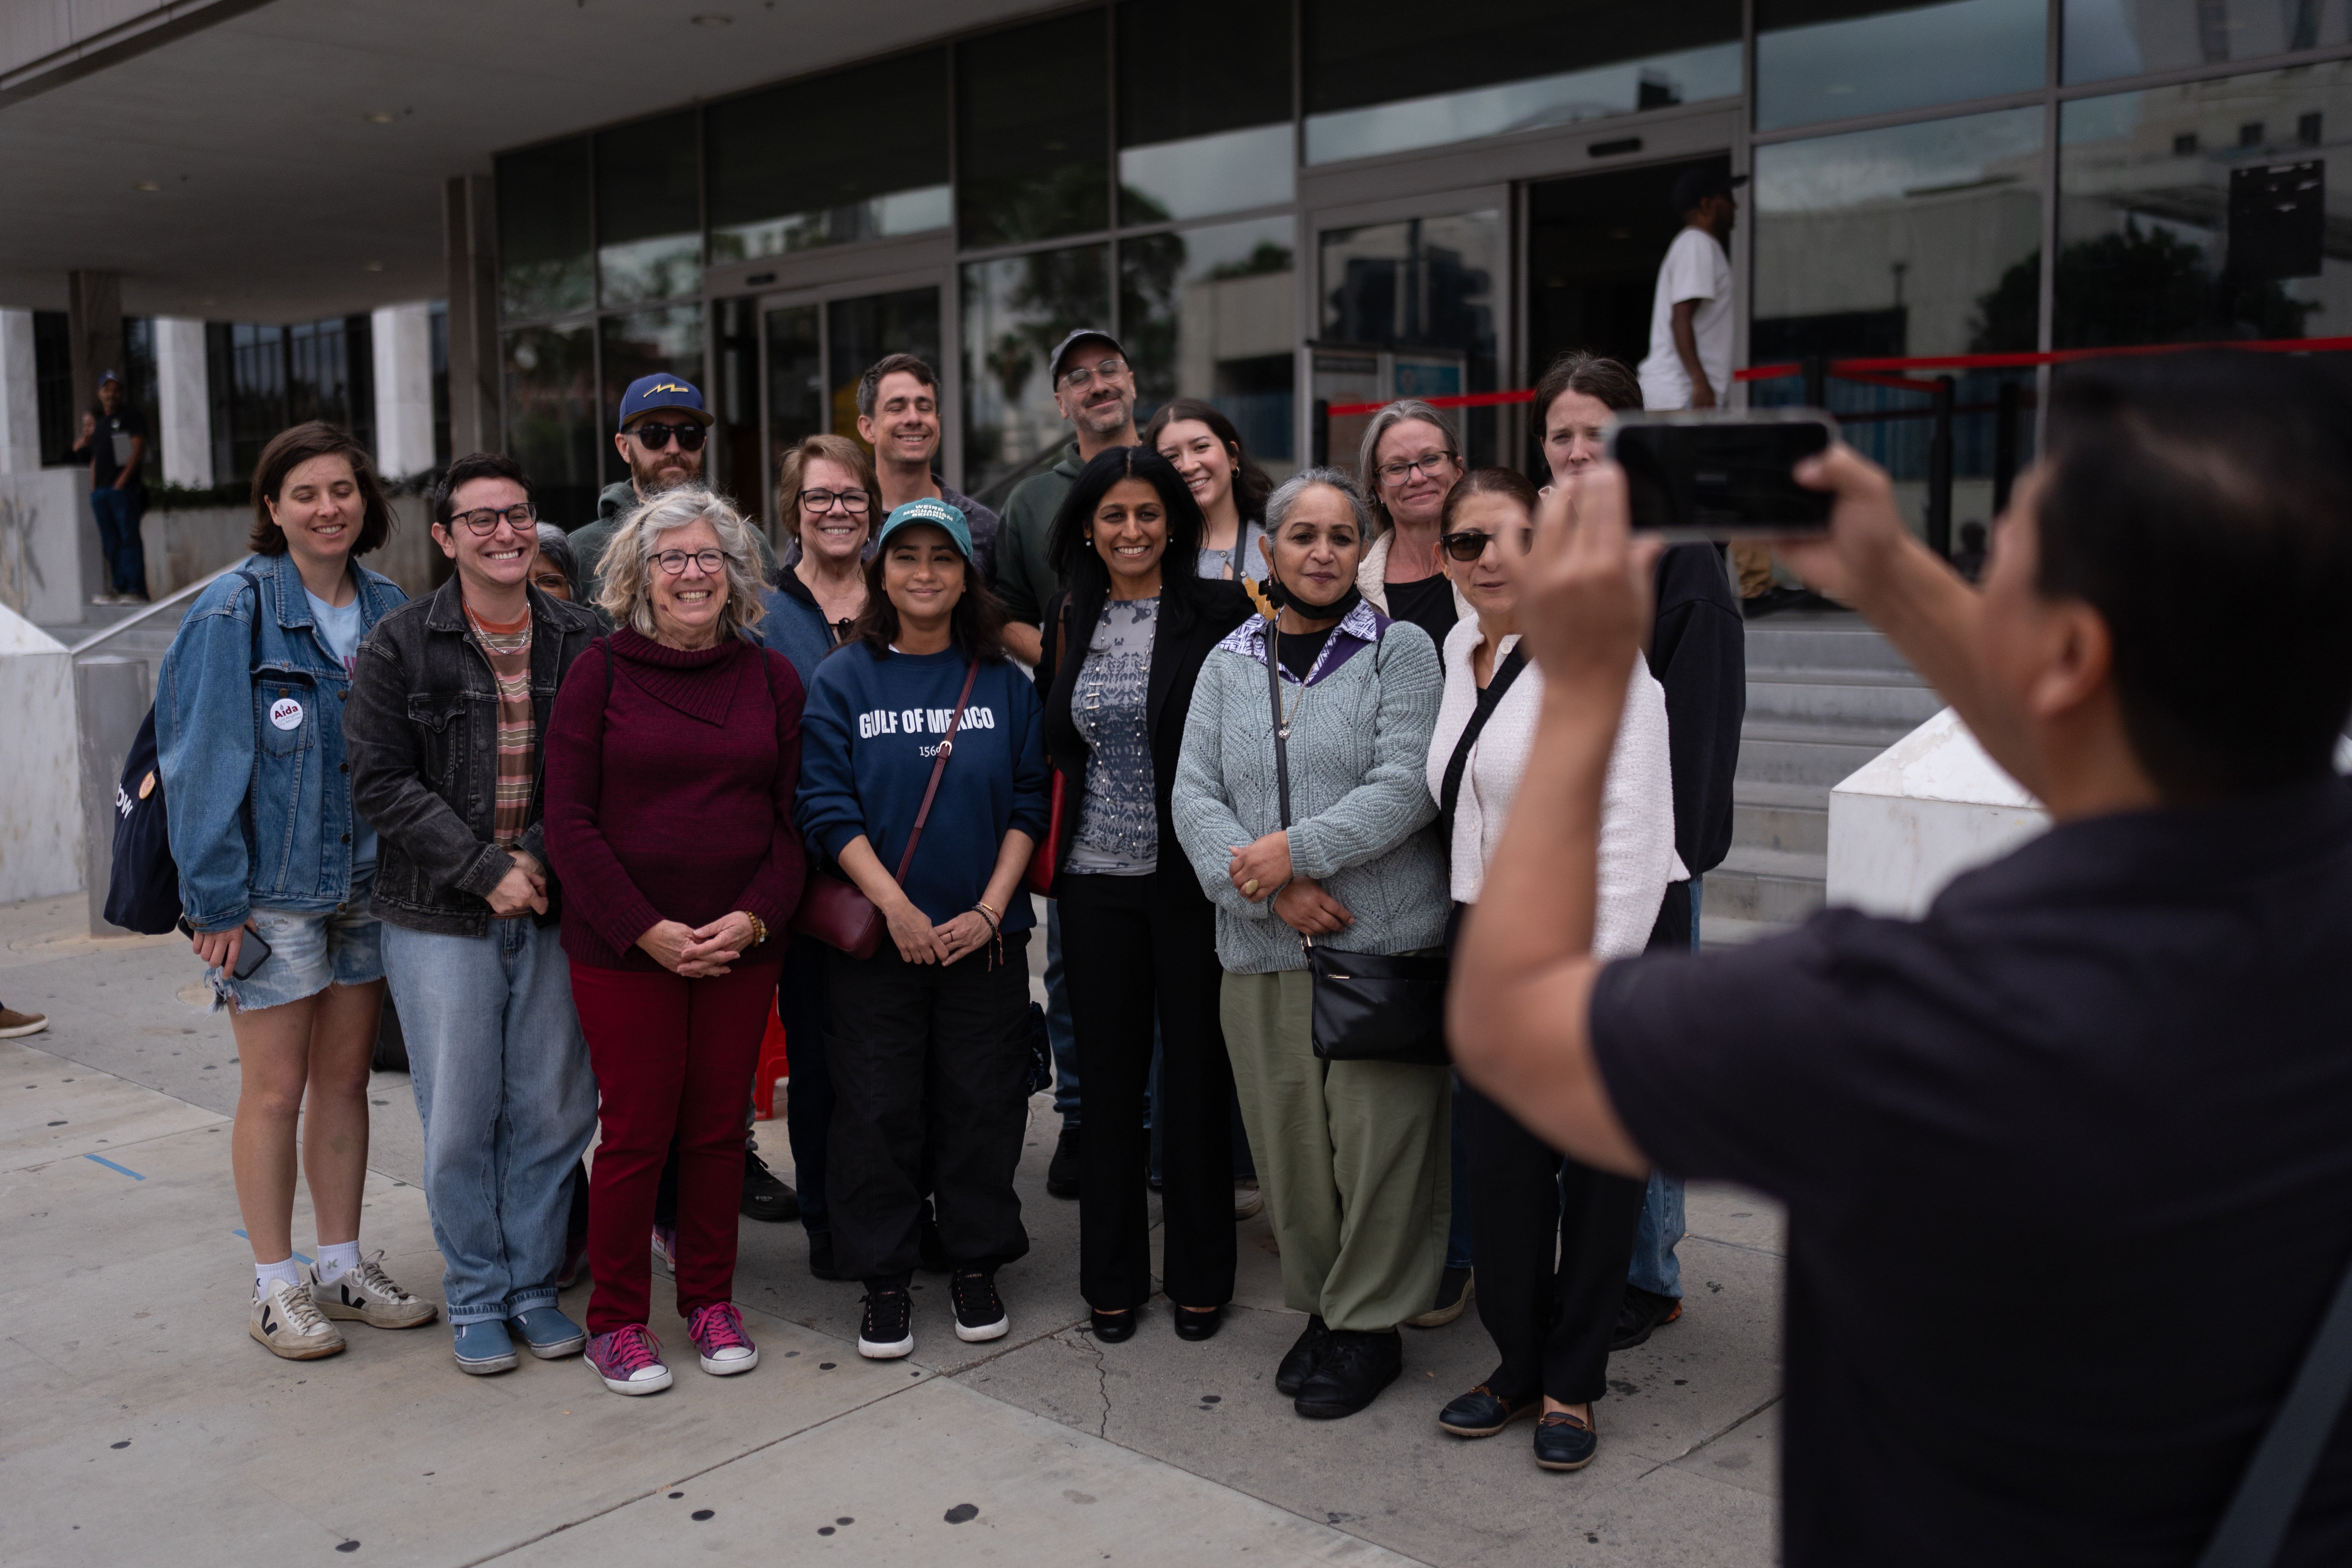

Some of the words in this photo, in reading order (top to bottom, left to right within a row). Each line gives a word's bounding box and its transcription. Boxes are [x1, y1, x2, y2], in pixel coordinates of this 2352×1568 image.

[903, 509, 953, 522] MECHANISM
[275, 706, 299, 720] Aida
[286, 716, 302, 724] Attorney
[859, 709, 898, 739] GULF
[902, 708, 924, 733] OF
